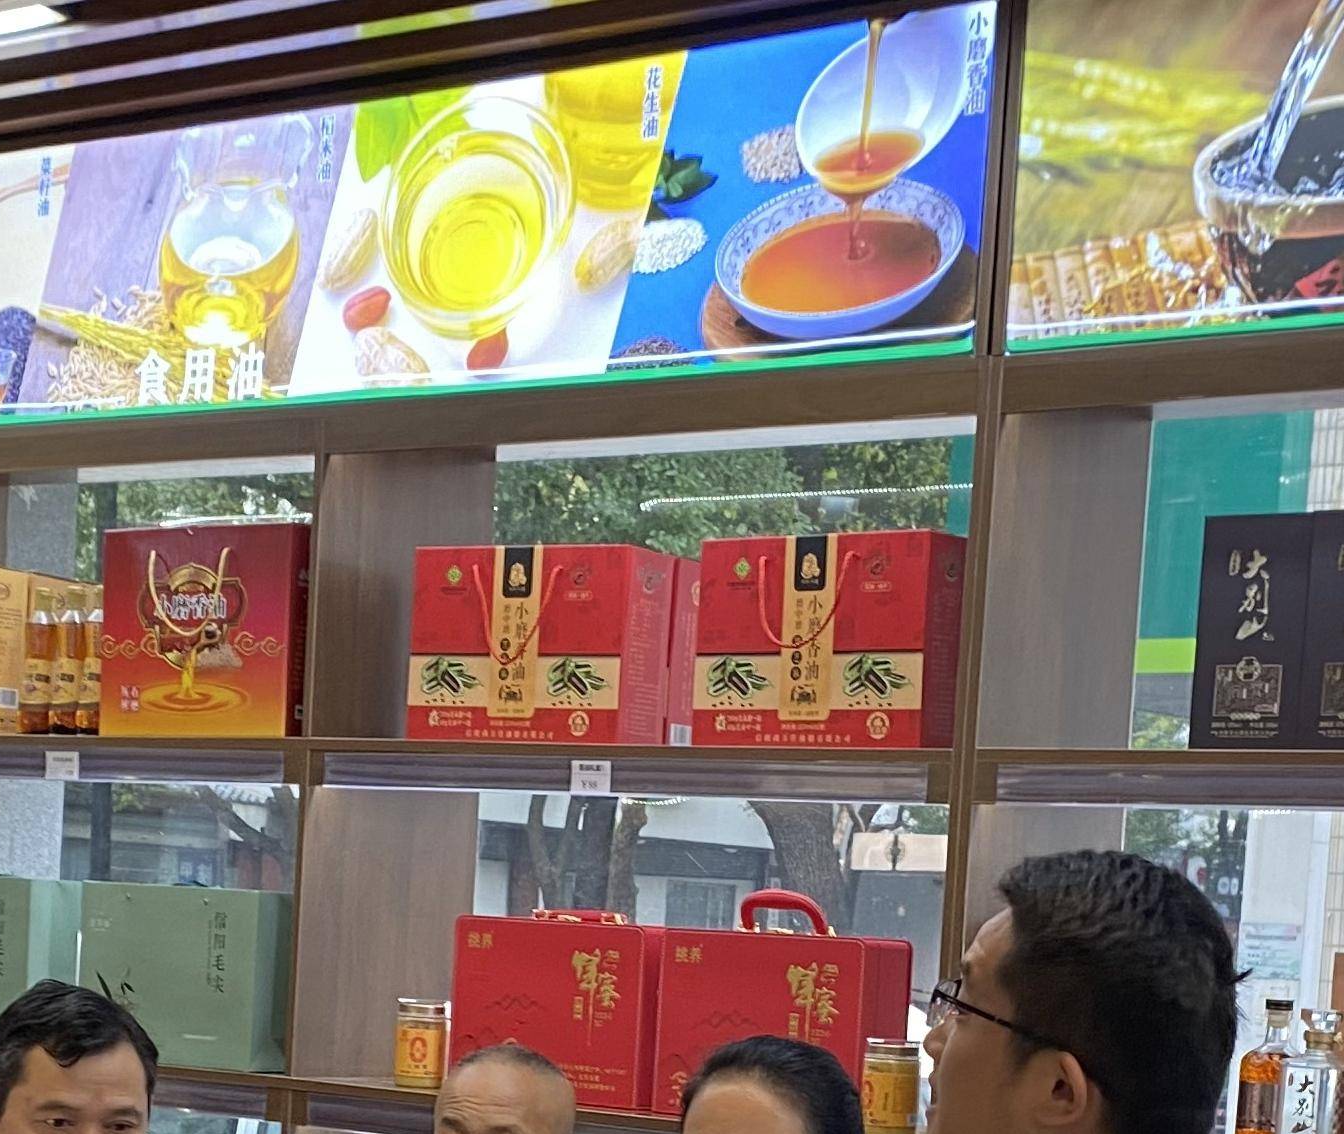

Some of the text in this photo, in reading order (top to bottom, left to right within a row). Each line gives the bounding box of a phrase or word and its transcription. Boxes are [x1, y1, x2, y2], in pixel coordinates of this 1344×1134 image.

[962, 11, 989, 116] 小磨香油
[642, 66, 662, 140] 花生油
[135, 343, 265, 405] 食用油
